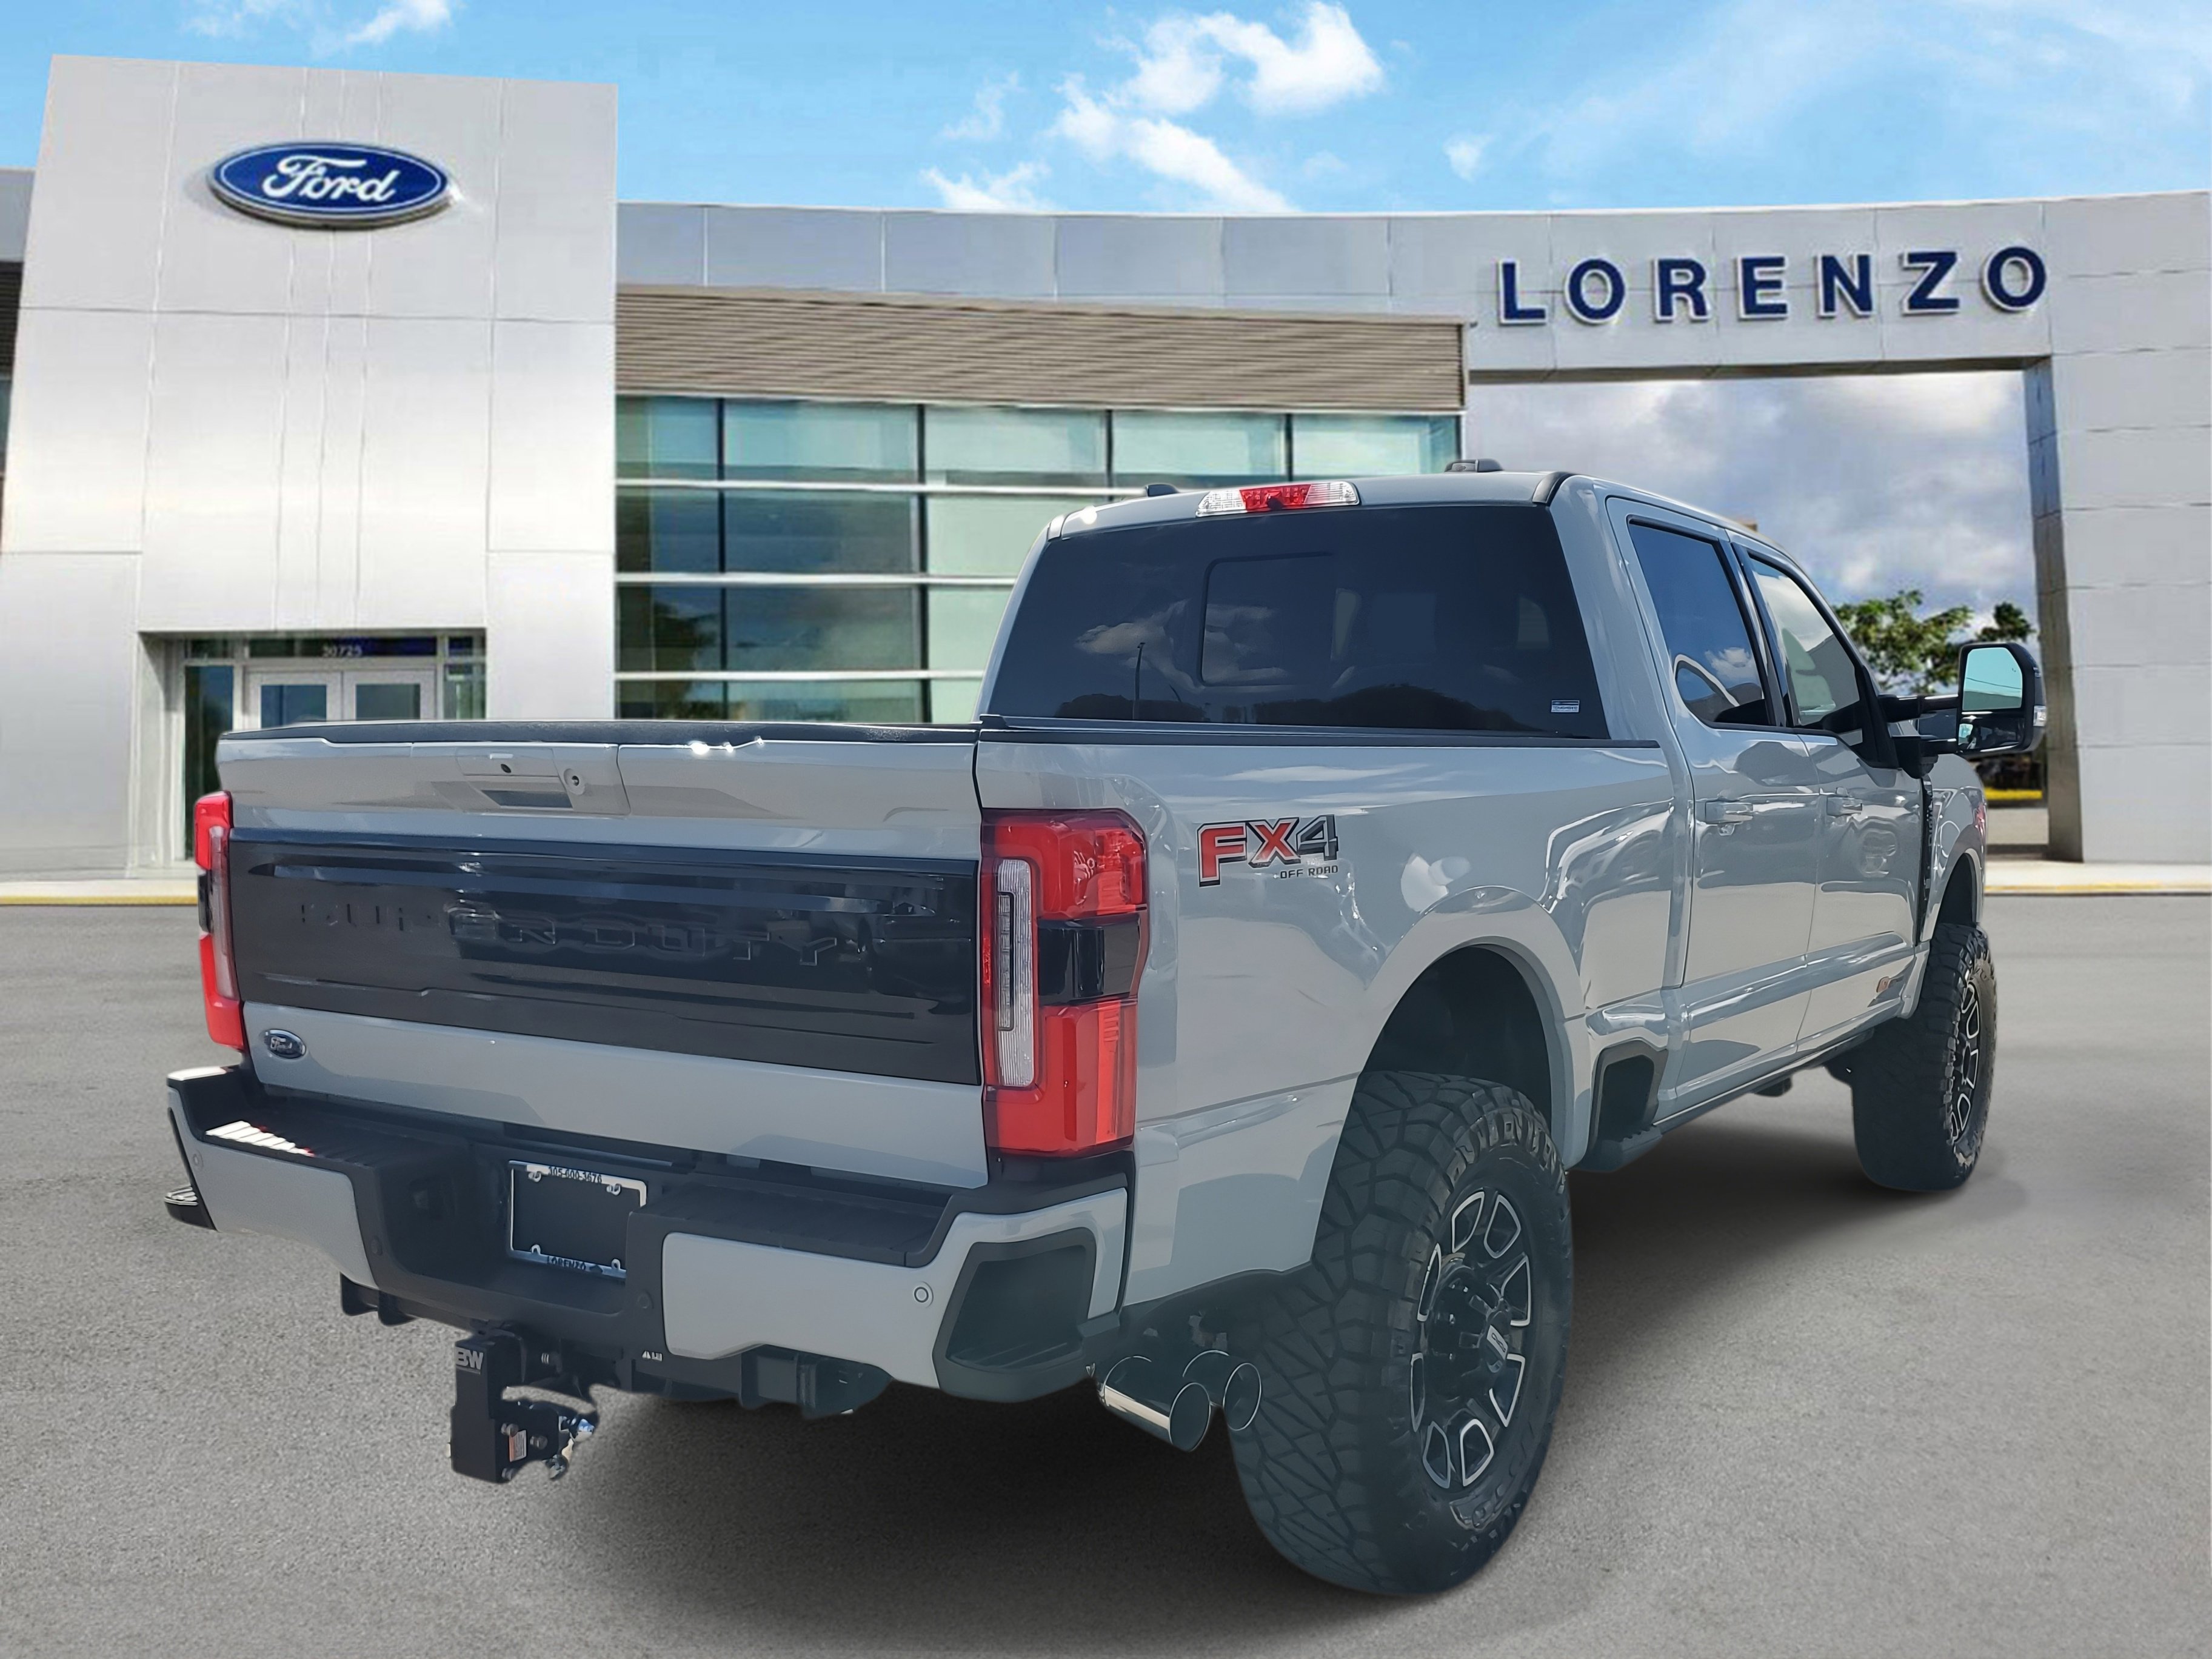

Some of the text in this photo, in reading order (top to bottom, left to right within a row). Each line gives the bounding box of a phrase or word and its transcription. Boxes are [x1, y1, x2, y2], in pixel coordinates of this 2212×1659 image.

[262, 154, 401, 202] Ford
[1497, 246, 2048, 326] LORENZO
[1197, 814, 1339, 887] FX4
[1280, 864, 1338, 879] OFF ROAD
[547, 1255, 586, 1271] LORENZO
